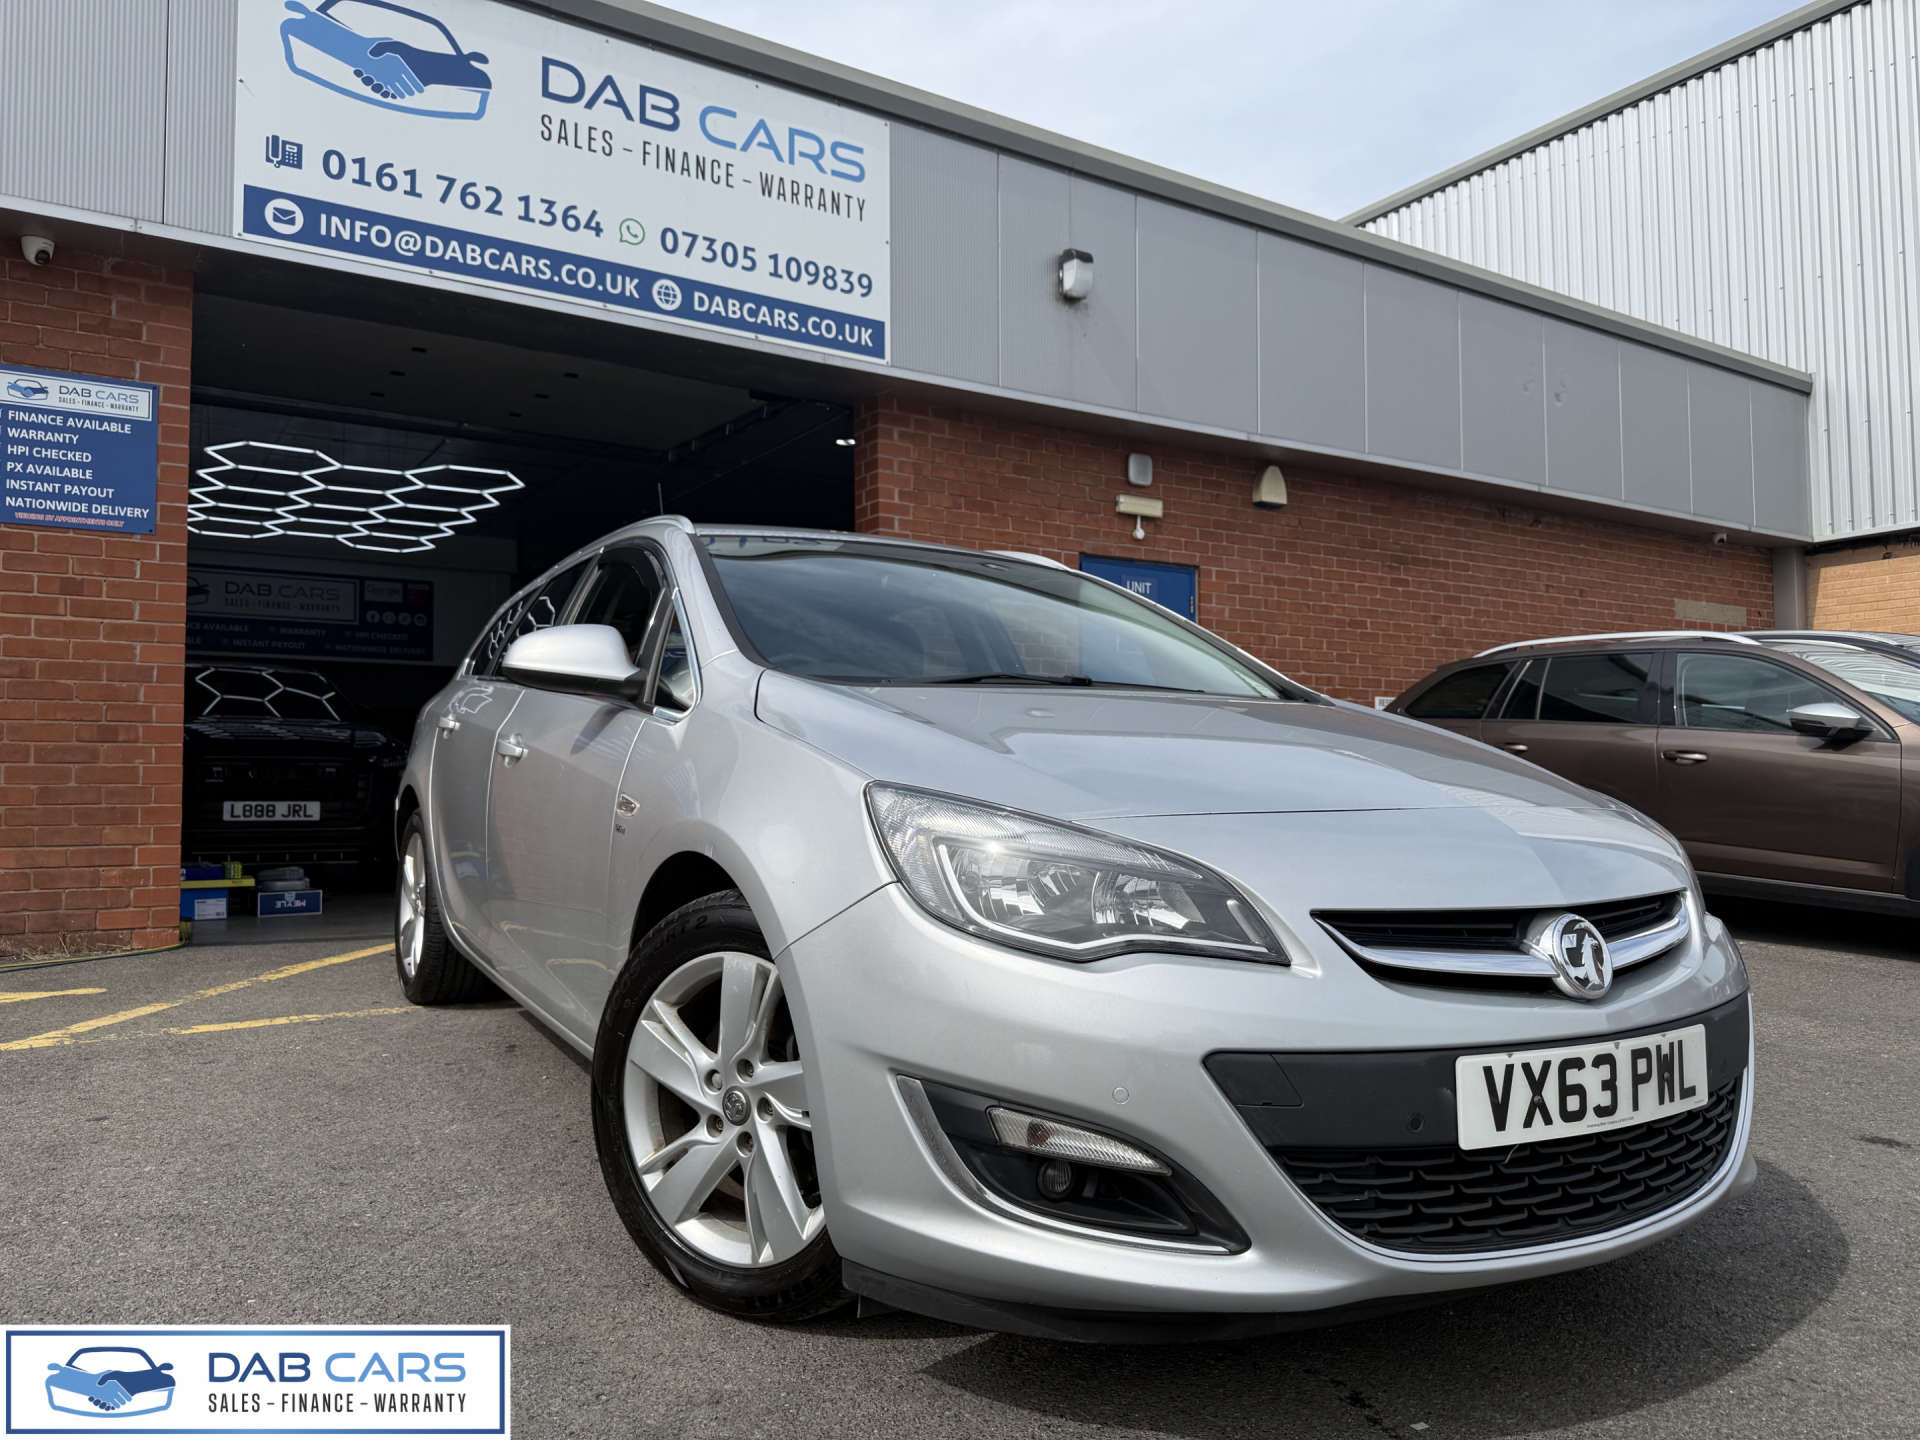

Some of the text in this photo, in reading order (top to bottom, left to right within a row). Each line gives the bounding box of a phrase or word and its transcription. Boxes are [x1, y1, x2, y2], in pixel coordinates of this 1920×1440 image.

[541, 55, 867, 184] DAB CARS
[540, 114, 614, 158] SALES
[642, 140, 735, 189] FINANCE
[760, 173, 867, 222] WARRANTY
[322, 148, 604, 239] 0161 762 1364
[319, 211, 640, 301] INFO@DABCARS.CO.UK
[659, 226, 874, 298] 07305 109839
[693, 290, 873, 349] DABCARS.CO.UK
[59, 385, 140, 404] DAB CARS
[8, 410, 132, 434] FINANCE AVAILABLE
[7, 427, 79, 445] WARRANTY
[7, 444, 92, 463] HPI CHECKED
[6, 461, 94, 480] PX AVAILABLE
[6, 479, 115, 499] INSTANT PAYOUT
[5, 495, 150, 519] NATIONWIDE DELIVERY
[224, 580, 341, 602] DAB CARS
[1126, 580, 1152, 594] UNIT
[230, 803, 314, 819] L888 JRL
[1482, 1040, 1697, 1132] VX63 PWL
